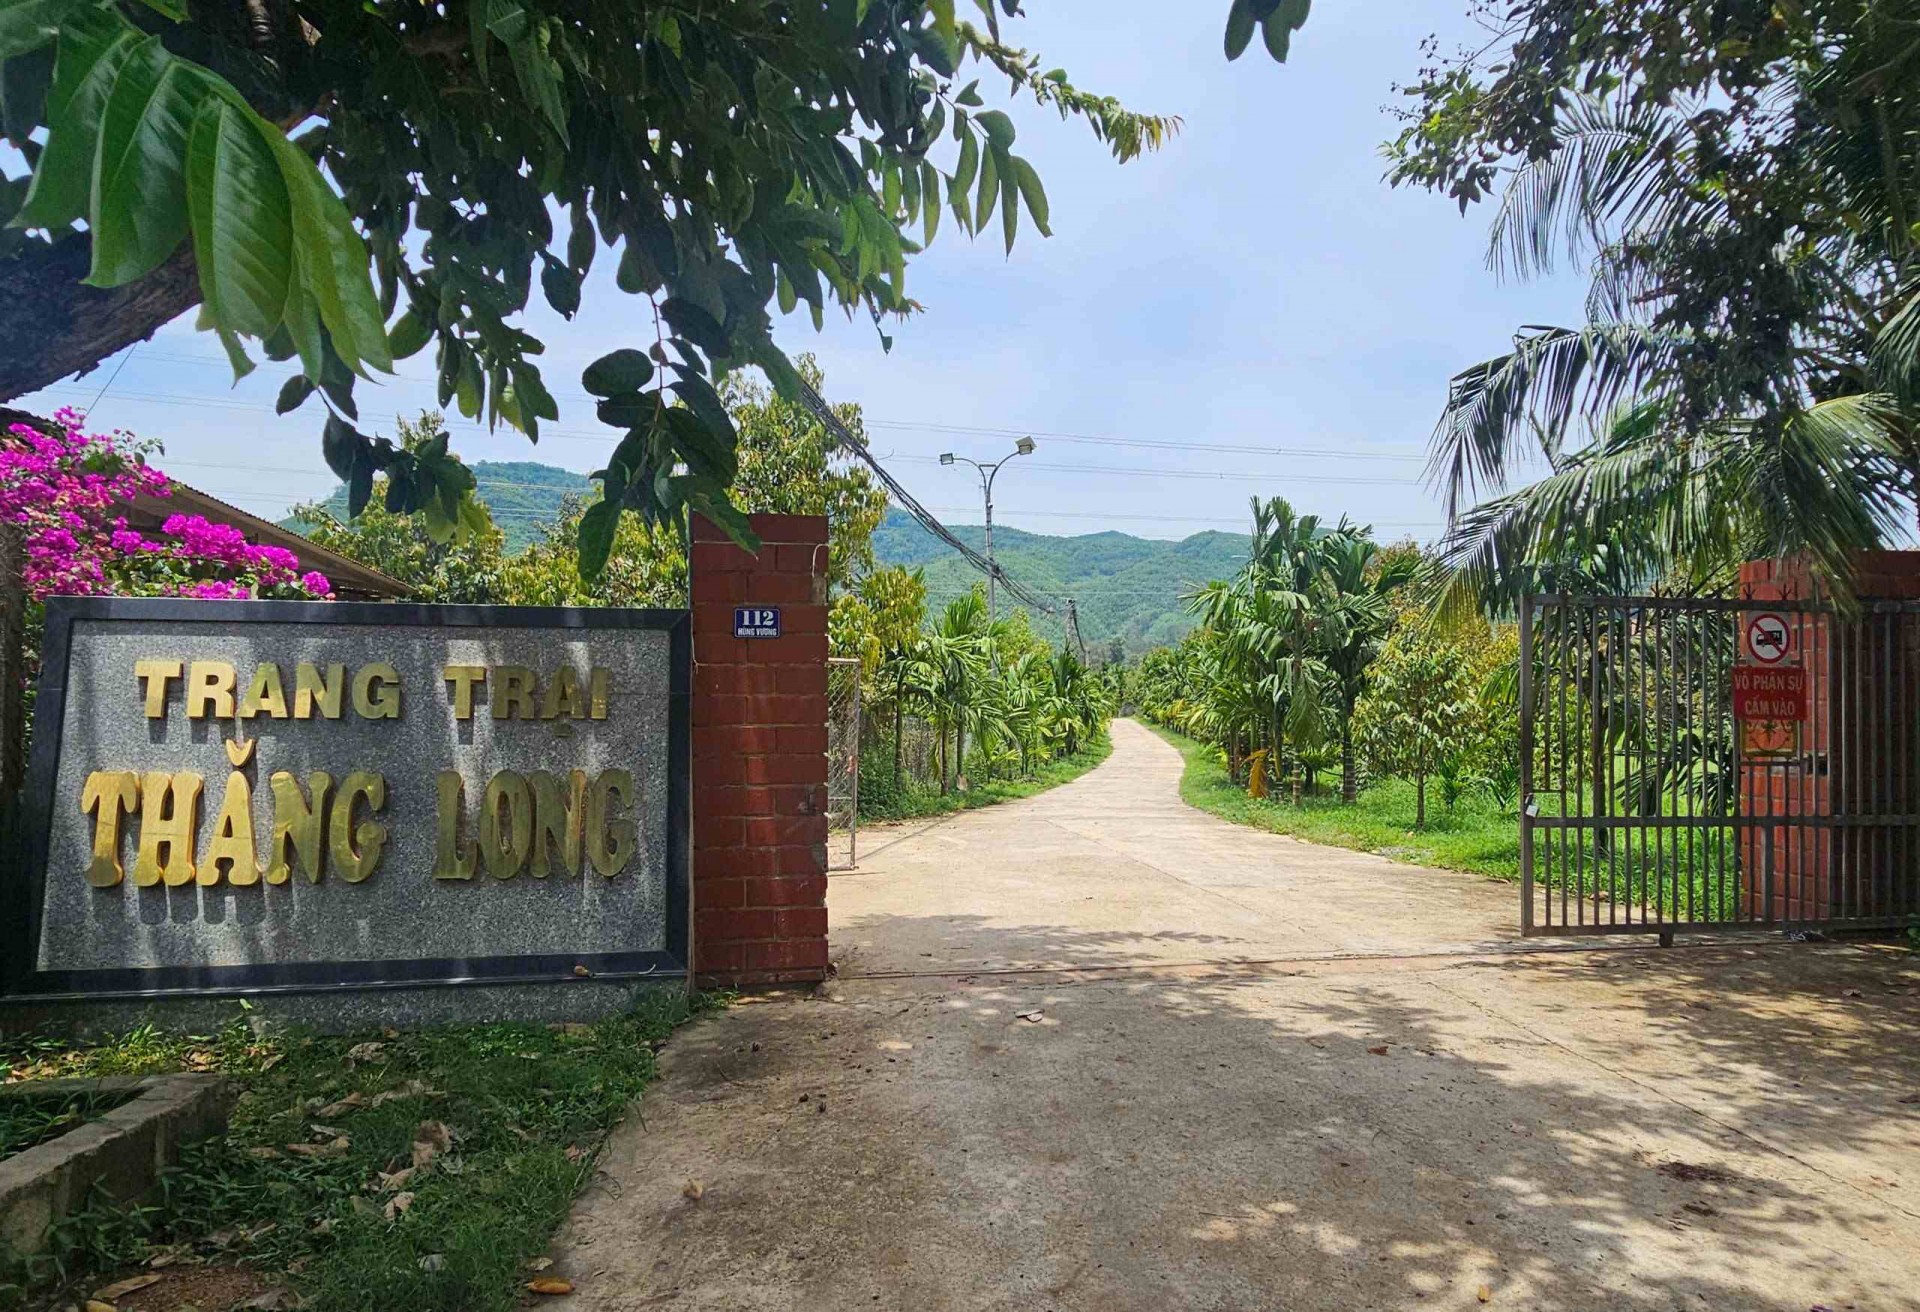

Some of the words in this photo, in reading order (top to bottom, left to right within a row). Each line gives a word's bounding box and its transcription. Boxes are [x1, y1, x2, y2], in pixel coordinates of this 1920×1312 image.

[742, 610, 774, 626] 112
[134, 660, 401, 720] TRANG
[443, 665, 610, 737] TRẠI
[1772, 697, 1796, 716] VÀO
[80, 738, 388, 888] THĂNG
[432, 769, 637, 880] LONG
